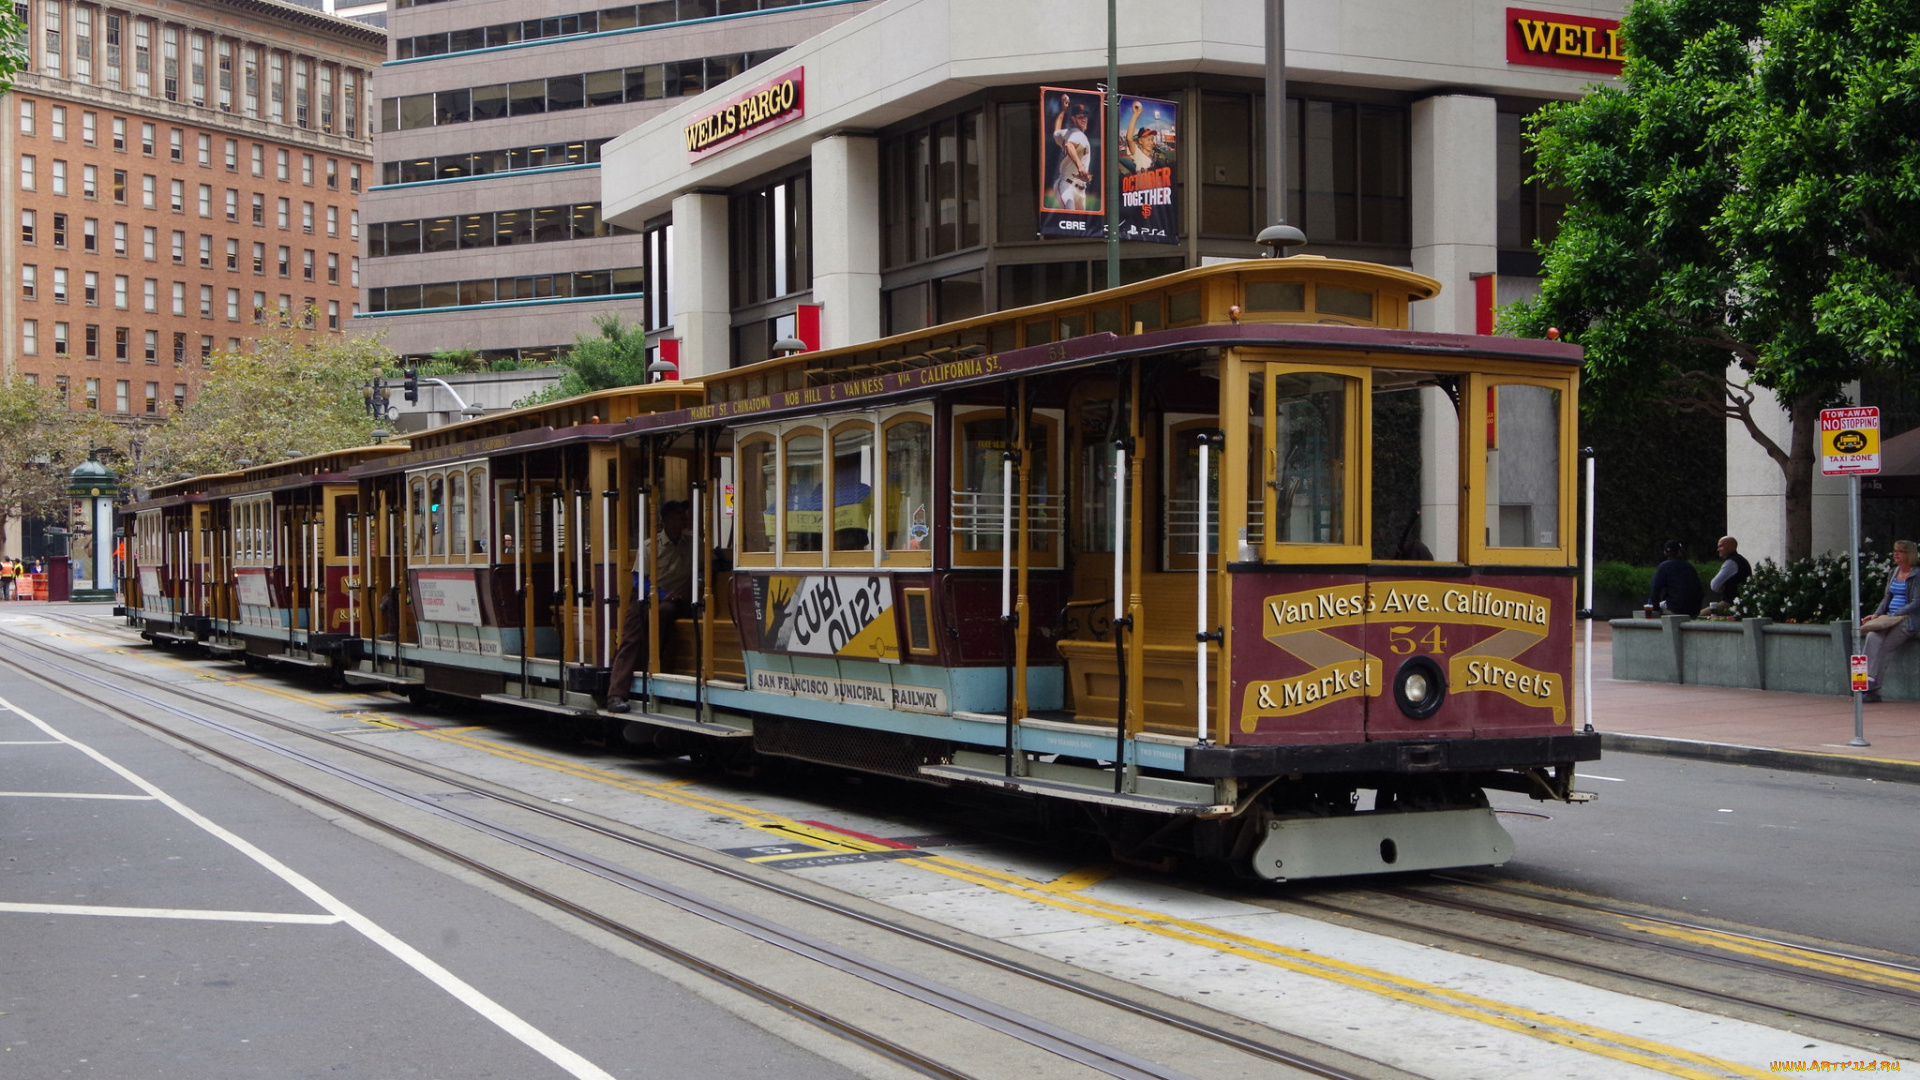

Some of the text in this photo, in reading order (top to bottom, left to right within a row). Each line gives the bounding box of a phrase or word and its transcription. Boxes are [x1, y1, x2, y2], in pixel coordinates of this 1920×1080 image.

[1518, 19, 1627, 60] WELL
[684, 79, 794, 152] WELLS FARGO
[1122, 166, 1172, 192] OCTOBER
[1122, 187, 1171, 207] TOGETHER
[1059, 220, 1086, 231] CBRE
[1141, 228, 1166, 237] PS4
[1049, 346, 1066, 361] 54
[691, 405, 715, 420] MARKET
[733, 397, 771, 414] CHINATOWN
[784, 391, 799, 406] NOB
[804, 388, 822, 404] HILL
[843, 382, 860, 397] VAN
[862, 378, 884, 393] NESS
[920, 360, 982, 385] CALIFORNIA
[1823, 417, 1877, 430] NO STOPPING
[1825, 409, 1873, 418] TOW-AWAY
[1829, 454, 1873, 463] TAXI ZONE
[1270, 600, 1315, 625] Van
[1318, 591, 1376, 617] Ness
[1444, 590, 1547, 625] California
[1389, 624, 1448, 654] 54
[758, 673, 775, 688] SAN
[777, 675, 829, 695] FRANCISCO
[892, 687, 937, 708] RAILWAY
[1258, 664, 1371, 709] & Market
[1468, 661, 1552, 698] Streets
